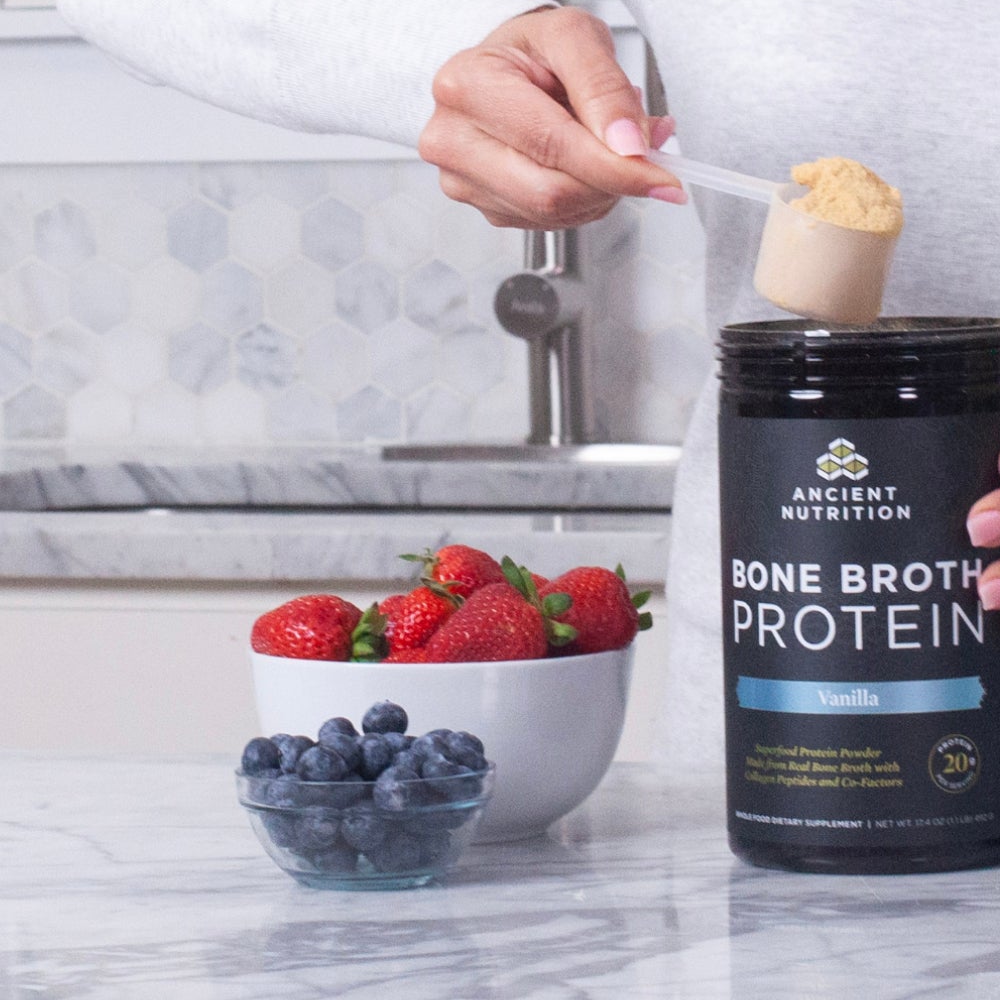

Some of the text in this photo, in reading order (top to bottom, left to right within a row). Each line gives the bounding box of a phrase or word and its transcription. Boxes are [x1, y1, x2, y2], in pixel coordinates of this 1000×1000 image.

[792, 486, 897, 501] ANCIENT
[781, 505, 911, 520] NUTRITION
[732, 558, 982, 594] BONE BROTH
[733, 600, 984, 651] PROTEIN
[818, 690, 880, 707] Vanilla
[840, 747, 882, 759] Powder
[938, 738, 973, 753] PROTEIN
[874, 761, 900, 773] with
[943, 752, 969, 774] 20
[818, 776, 840, 788] and
[804, 818, 864, 829] SUPPLEMENT
